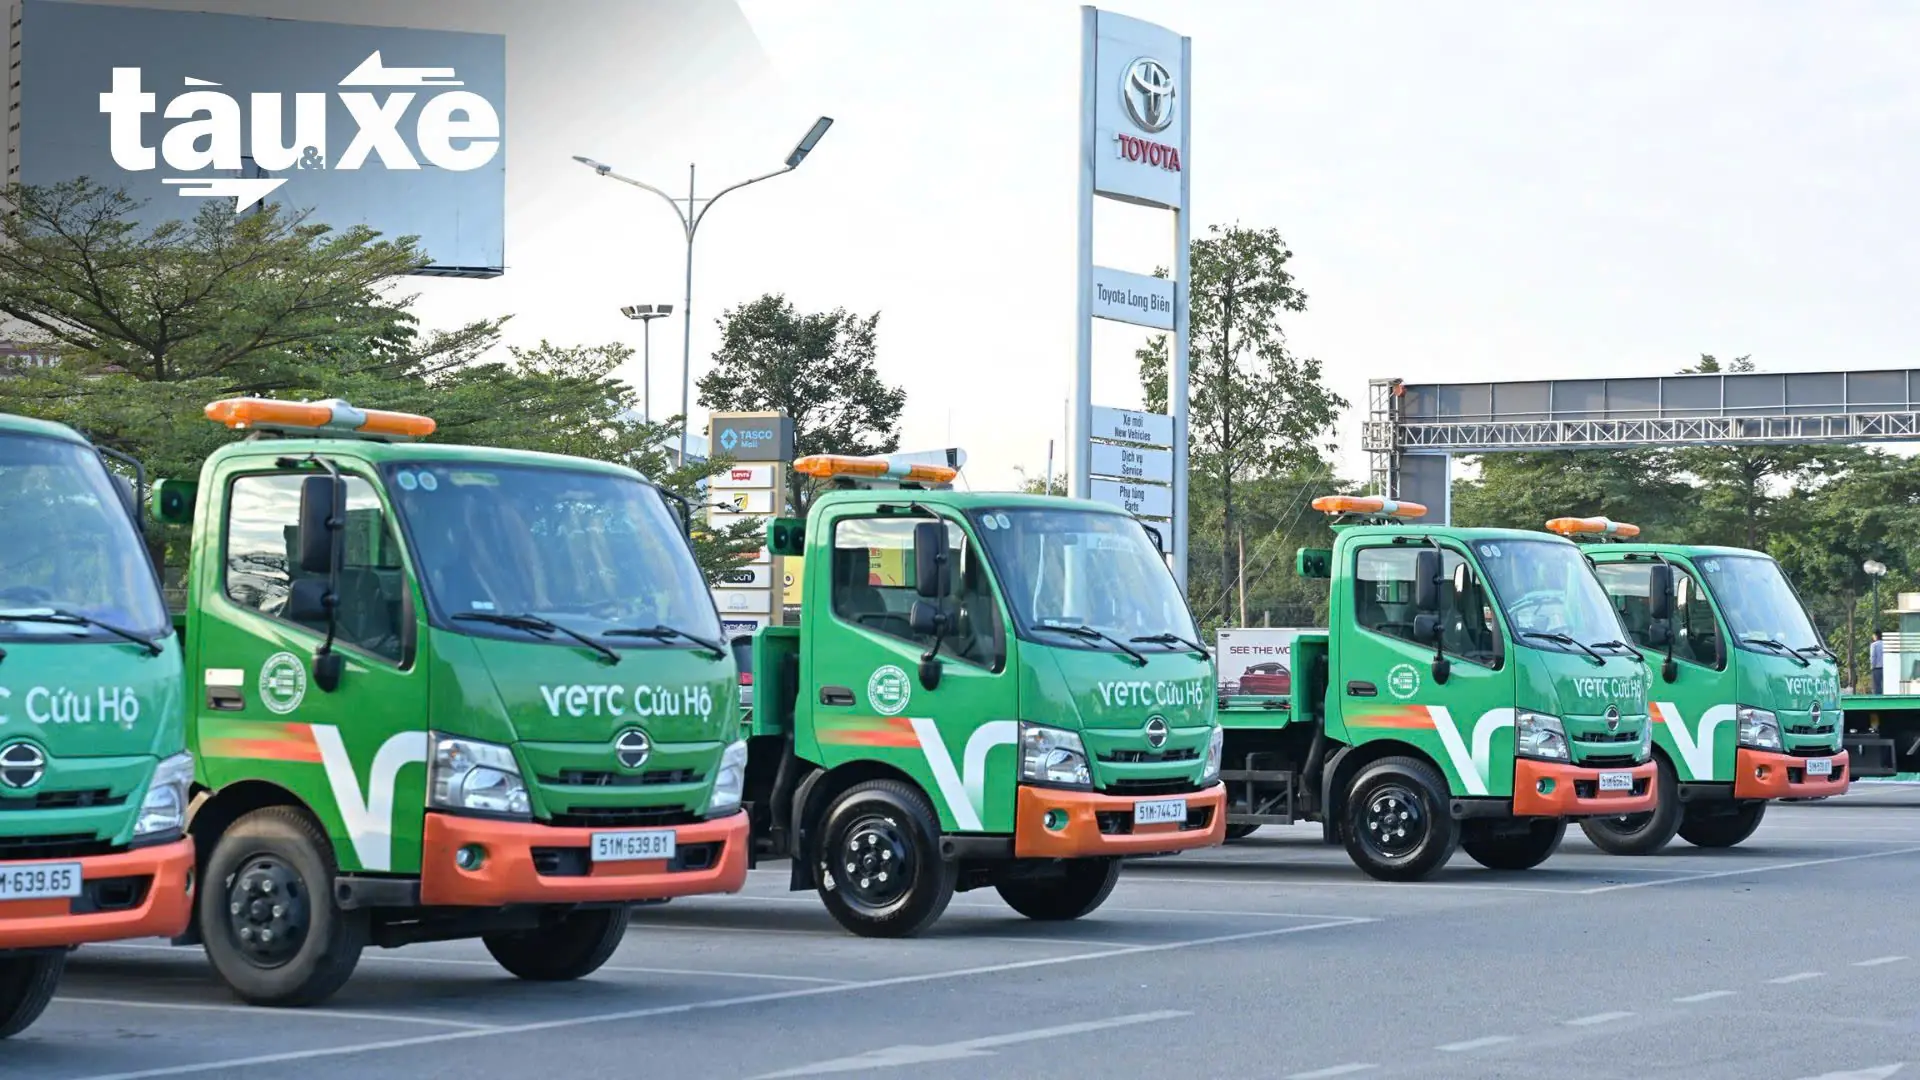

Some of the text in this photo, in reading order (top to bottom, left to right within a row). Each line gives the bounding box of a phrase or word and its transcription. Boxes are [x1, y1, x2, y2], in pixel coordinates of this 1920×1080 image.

[1117, 132, 1181, 172] TOYOTA
[1097, 283, 1170, 313] Toyota Long Biên
[1123, 414, 1131, 425] Xe
[740, 430, 773, 440] TASCO
[1115, 427, 1151, 441] New Vehicles
[1122, 450, 1144, 466] Dịch vụ
[1121, 464, 1143, 476] Service
[1119, 486, 1145, 502] Phụ tùng
[1124, 500, 1139, 512] Parts
[1230, 646, 1249, 654] SEE
[1253, 646, 1273, 654] THE
[634, 684, 679, 717] Cứu
[684, 685, 712, 722] Hộ
[1156, 681, 1183, 706] Cứu
[1186, 682, 1203, 710] Hộ
[25, 686, 90, 724] Cứu
[98, 686, 140, 730] Hộ
[1139, 804, 1182, 820] 51M-744.37
[599, 835, 668, 857] 51M-639.81
